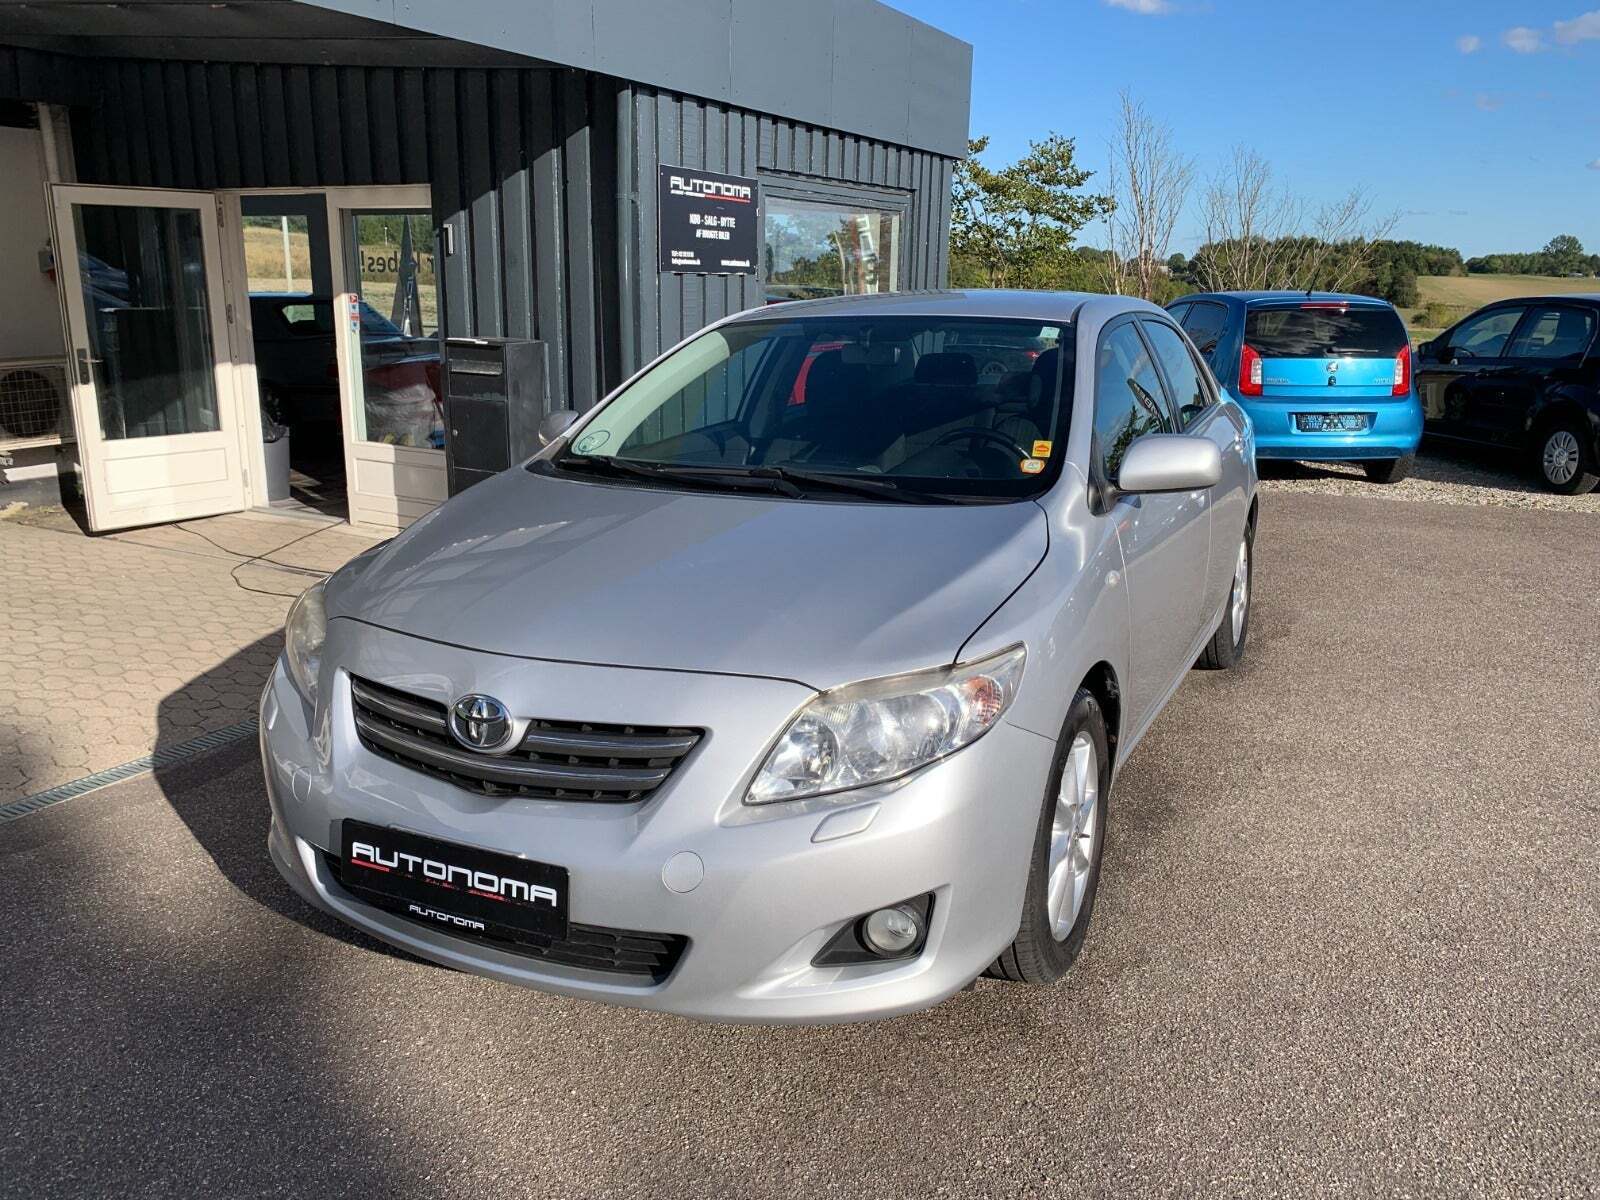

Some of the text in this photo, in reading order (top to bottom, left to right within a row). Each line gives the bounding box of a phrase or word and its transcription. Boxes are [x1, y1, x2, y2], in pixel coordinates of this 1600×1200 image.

[670, 176, 751, 199] AUTONOMA
[352, 841, 557, 907] AUTONOMA
[409, 904, 485, 931] AUTONOMA
